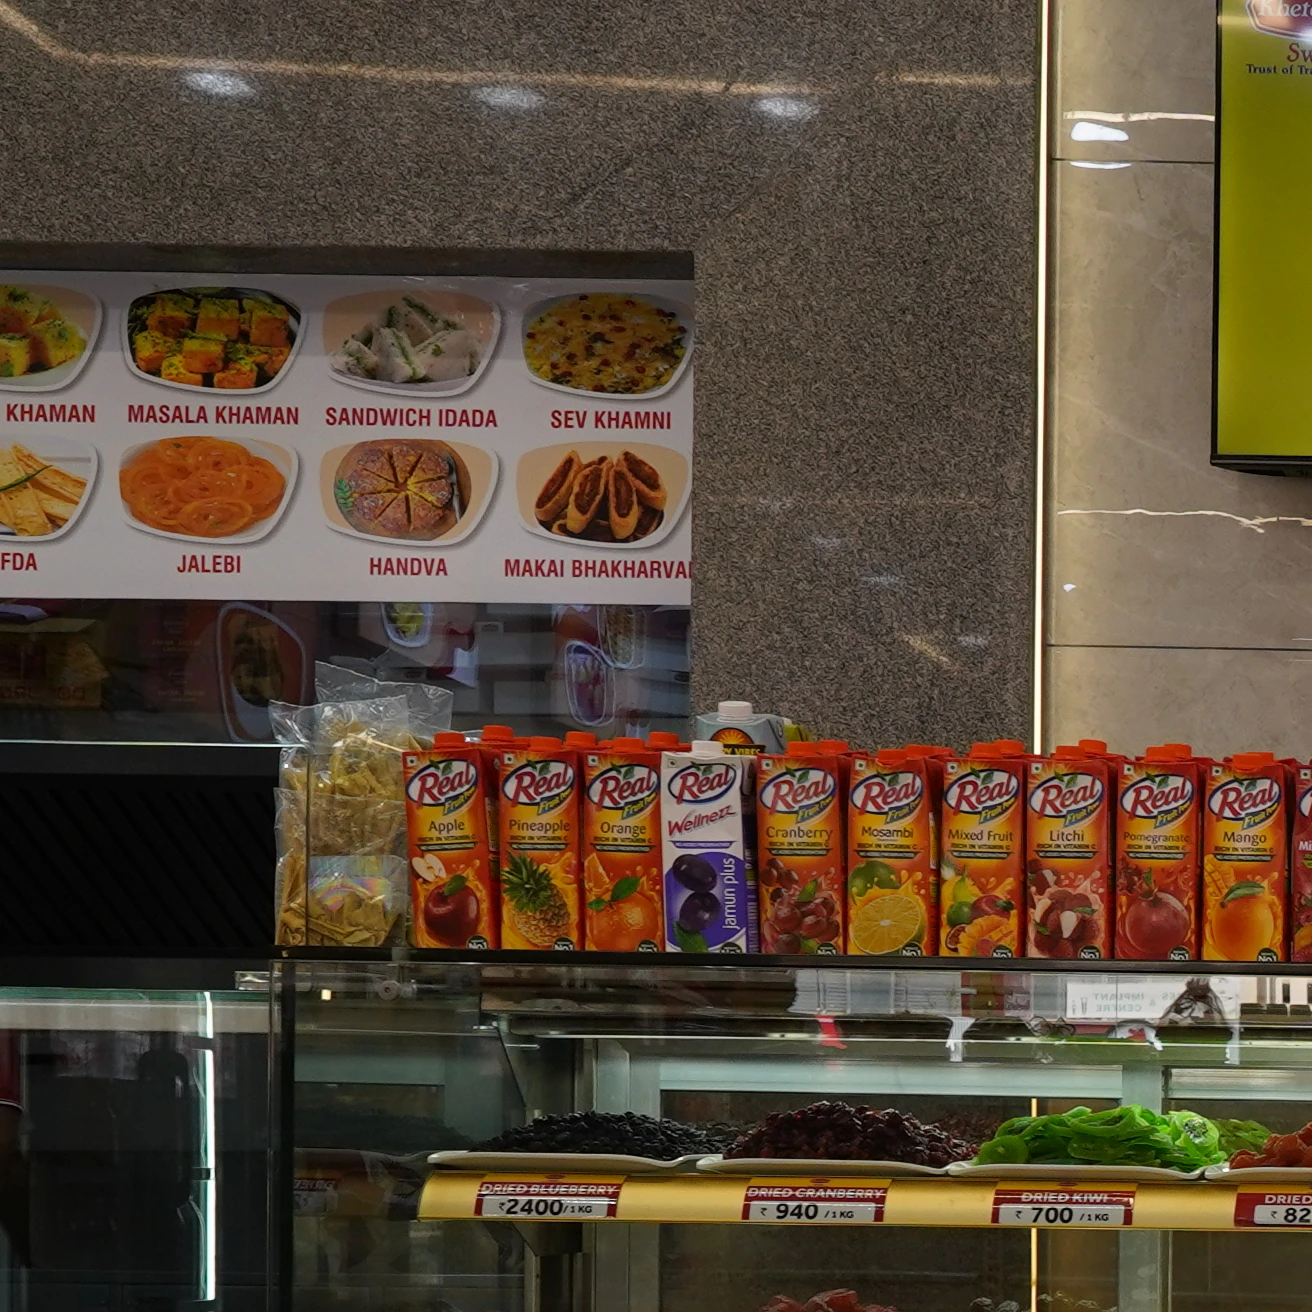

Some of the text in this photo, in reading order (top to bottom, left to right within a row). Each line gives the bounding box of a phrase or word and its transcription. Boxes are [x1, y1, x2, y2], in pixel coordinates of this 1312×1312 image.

[1246, 63, 1277, 74] Trust
[1281, 64, 1294, 75] of
[6, 403, 96, 424] KHAMAN
[127, 404, 299, 426] MASALA KHAMAN
[325, 406, 498, 428] SANDWICH IDADA
[550, 409, 672, 430] SEV KHAMNI
[177, 554, 242, 574] JALEBI
[369, 557, 448, 577] HANDVA
[504, 558, 565, 578] MAKAI
[417, 762, 473, 808] Real
[506, 762, 564, 807] Real
[596, 764, 653, 812] Real
[677, 763, 730, 804] Real
[770, 772, 830, 814] Real
[953, 772, 1014, 815] Real
[859, 774, 919, 815] Real
[1038, 776, 1098, 819] Real
[1129, 778, 1189, 820] Real
[1215, 779, 1274, 822] Real
[428, 819, 465, 834] Apple
[509, 818, 571, 835] Pineapple
[600, 821, 647, 837] Orange
[668, 805, 738, 836] Wellnezz
[766, 826, 833, 842] Cranberry
[861, 826, 914, 839] Mosambi
[948, 828, 1014, 842] Mixed Fruit
[1050, 829, 1084, 842] Litchi
[1123, 831, 1190, 844] Pomegranate
[1223, 831, 1267, 846] Mango
[720, 858, 740, 884] plus
[482, 1184, 617, 1195] DRIED BLUEBERRY
[747, 1188, 885, 1199] DRIED CRANBERRY
[1021, 1192, 1108, 1203] DRIED KIWI
[1264, 1194, 1312, 1204] DRIED
